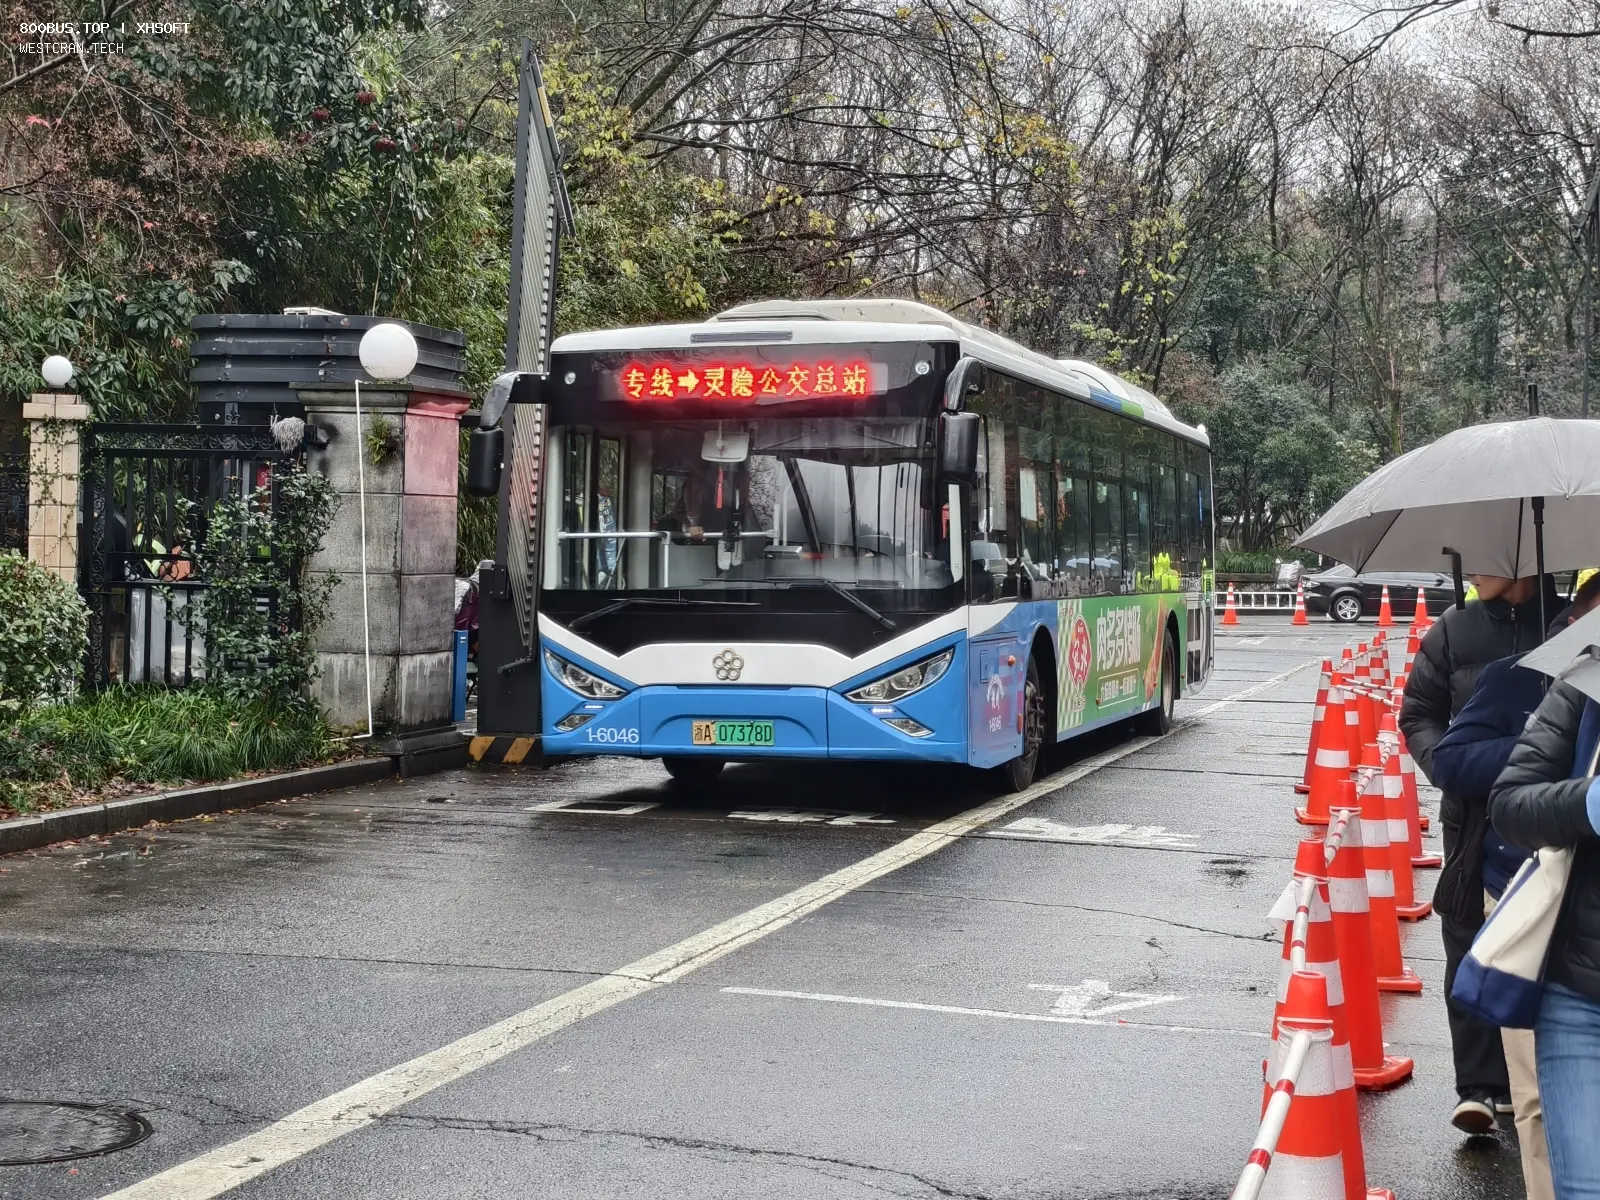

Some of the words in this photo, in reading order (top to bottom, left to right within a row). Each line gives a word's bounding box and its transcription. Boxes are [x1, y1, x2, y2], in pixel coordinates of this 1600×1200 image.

[622, 366, 674, 398] 专线
[702, 364, 868, 398] 灵隐公交总站
[585, 728, 640, 744] 1-6046
